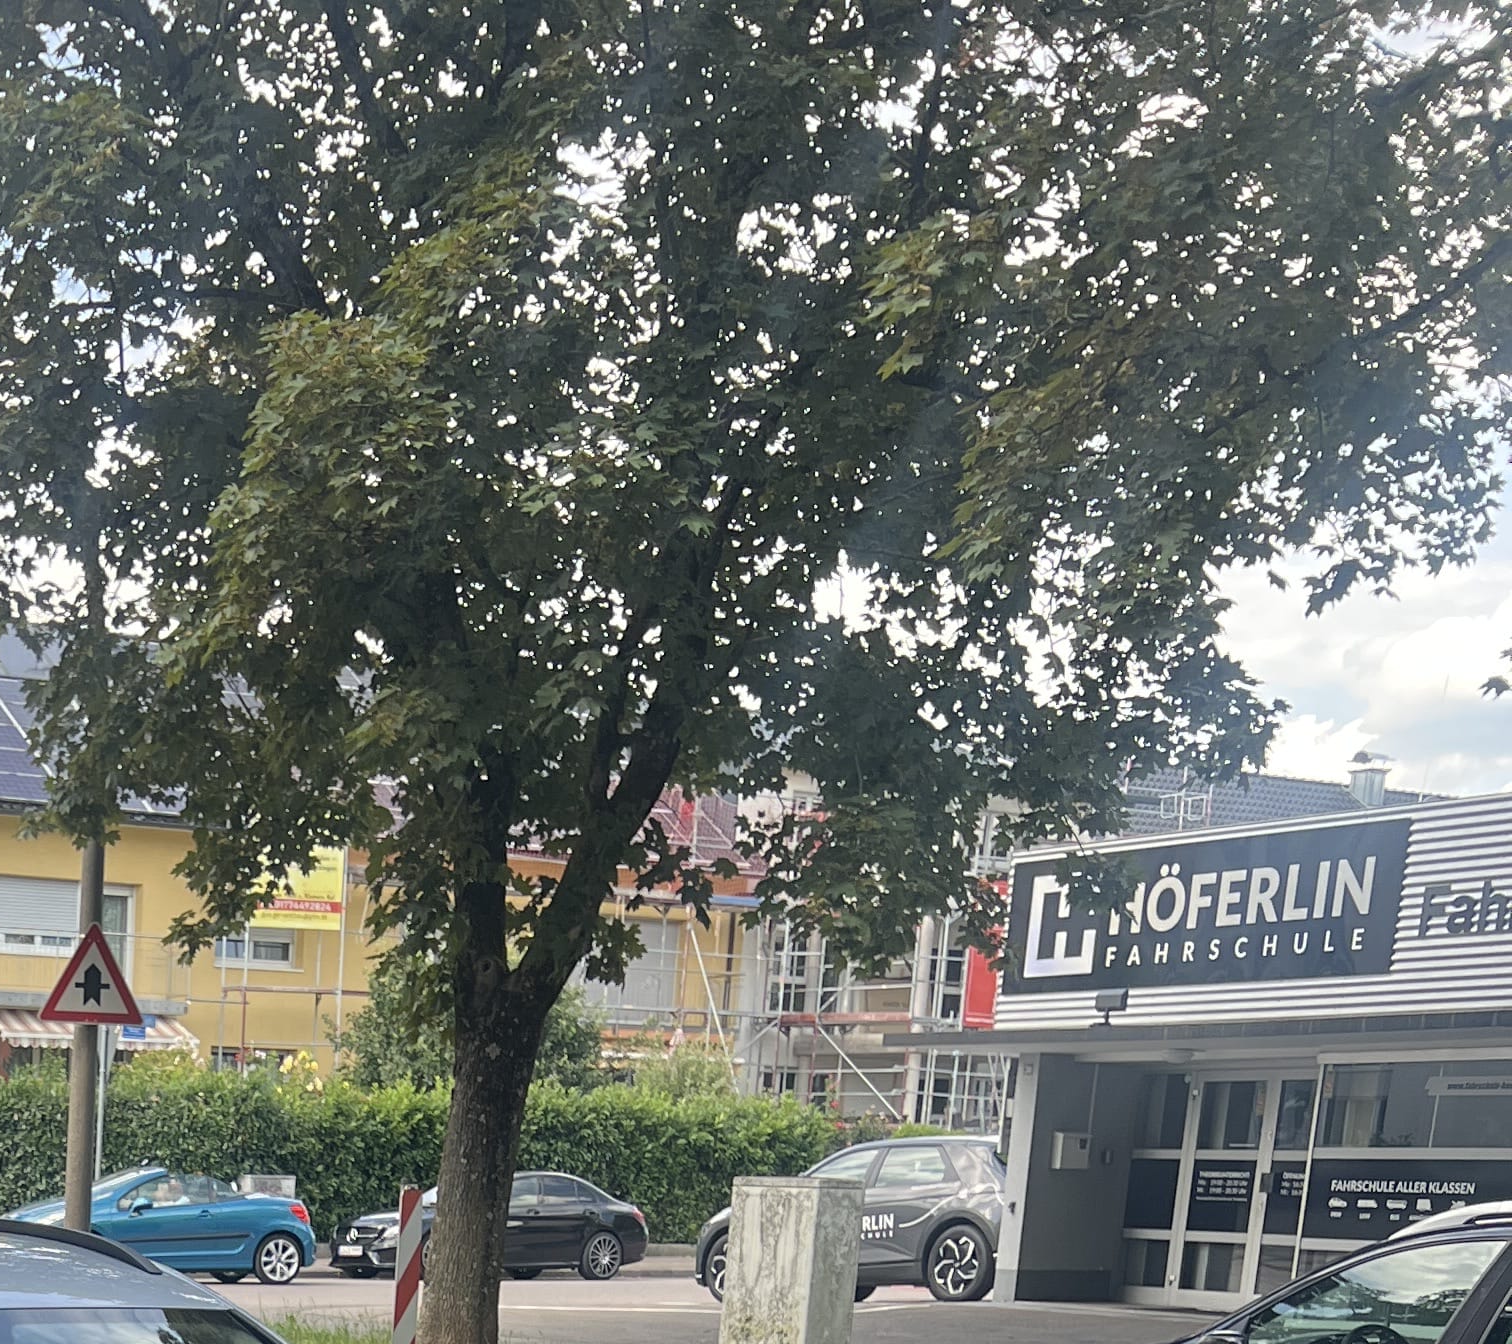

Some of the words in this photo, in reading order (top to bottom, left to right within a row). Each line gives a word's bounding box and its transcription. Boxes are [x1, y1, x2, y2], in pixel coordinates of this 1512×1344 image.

[1107, 856, 1377, 936] HÖFERLIN
[1418, 879, 1512, 938] Fah
[1104, 927, 1366, 968] FAHRSCHULE
[1331, 1178, 1395, 1193] FAHRSCHULE
[1395, 1180, 1427, 1194] ALLER
[1428, 1181, 1476, 1194] KLASSEN
[862, 1213, 894, 1231] RLIN
